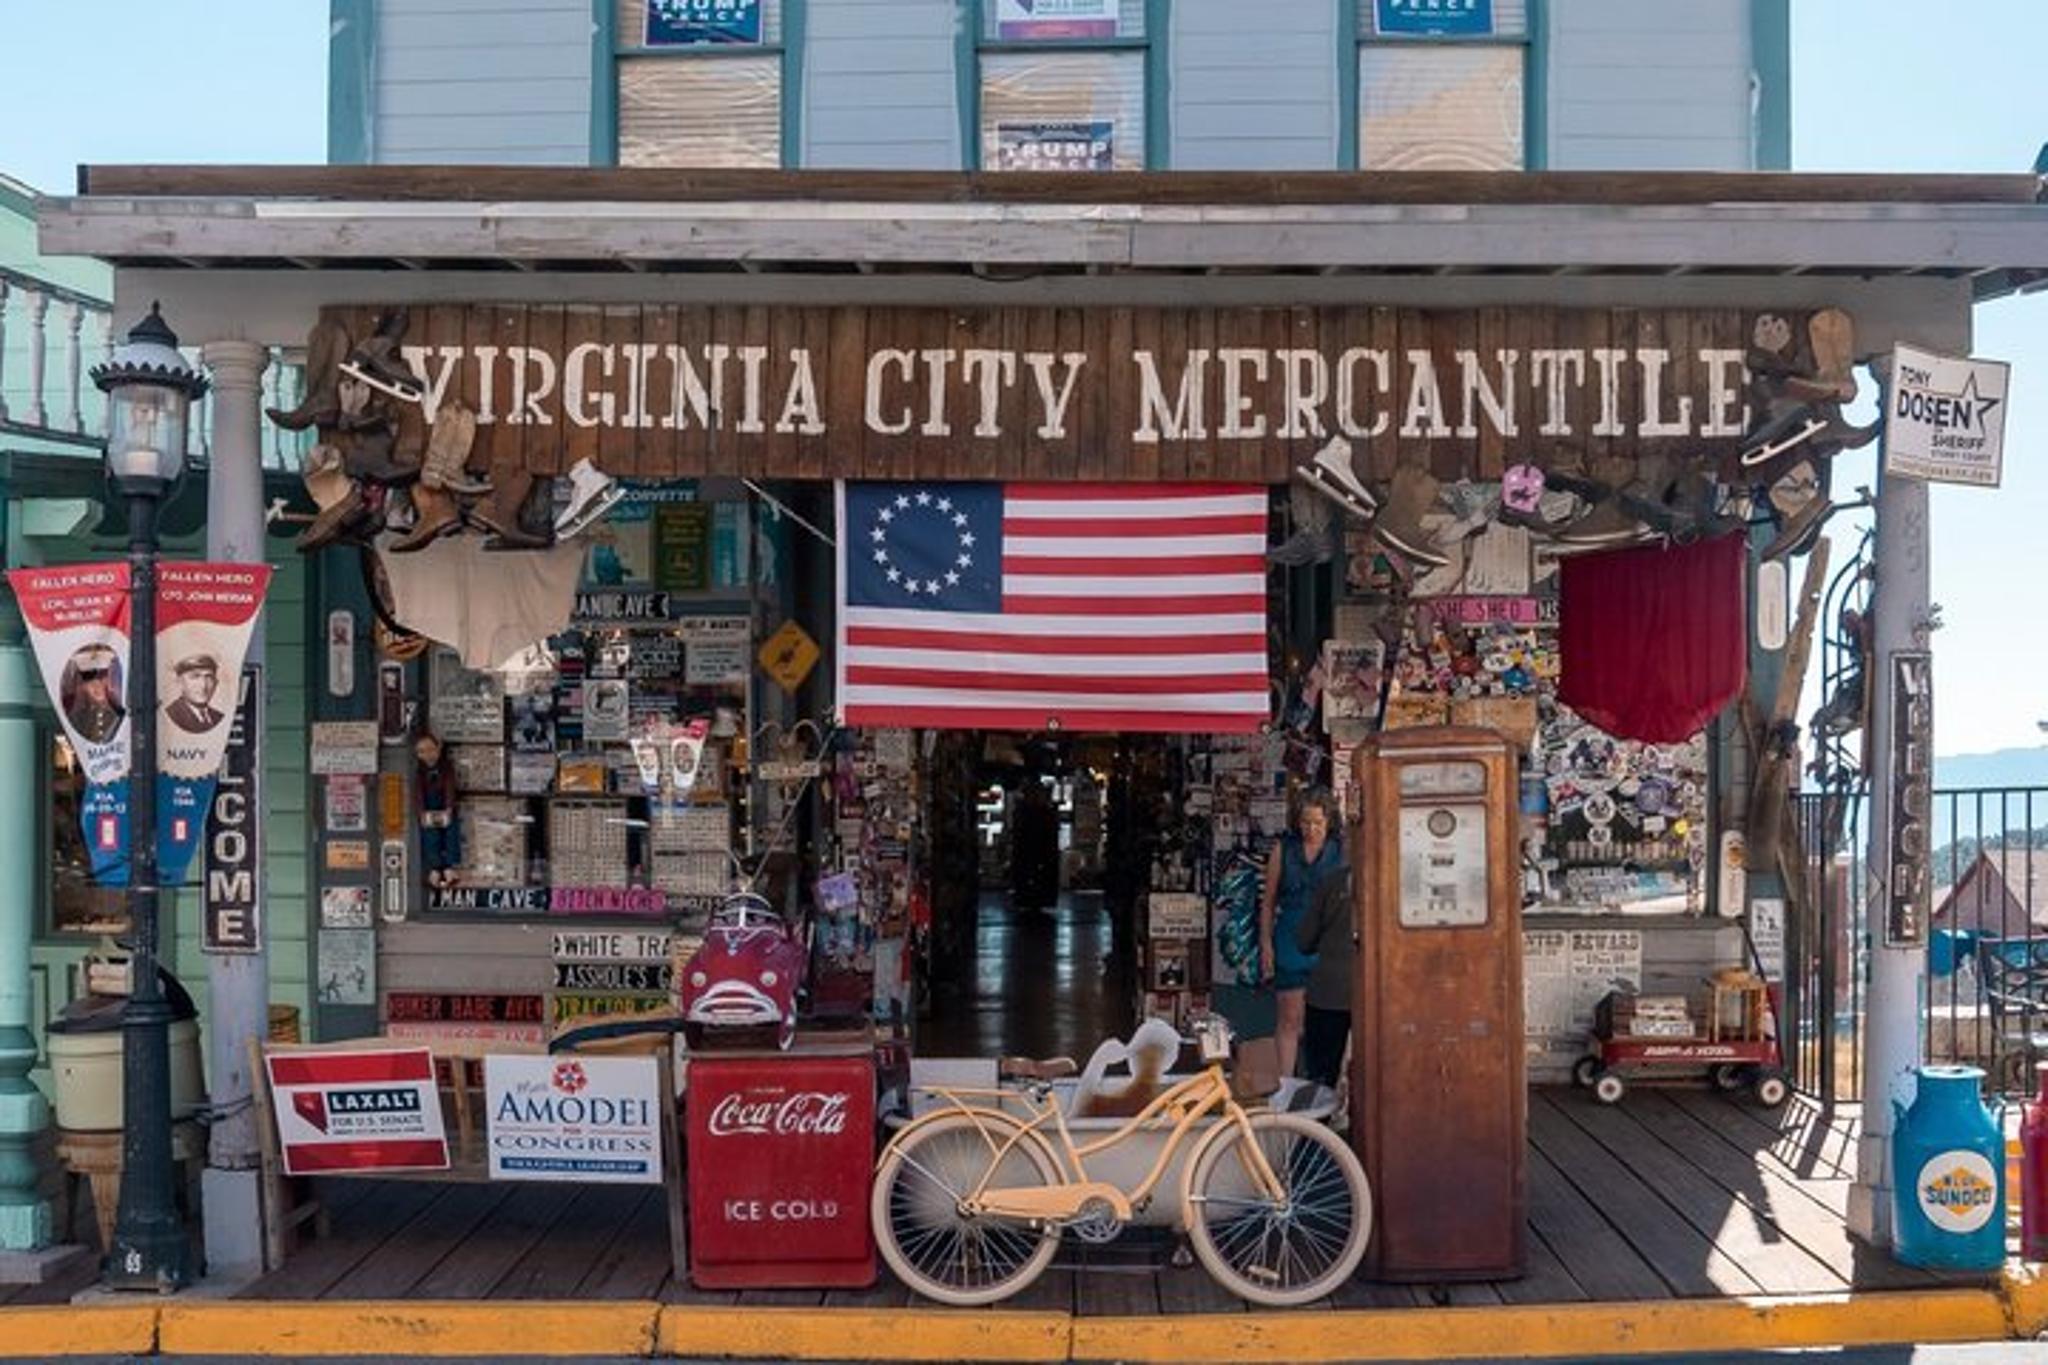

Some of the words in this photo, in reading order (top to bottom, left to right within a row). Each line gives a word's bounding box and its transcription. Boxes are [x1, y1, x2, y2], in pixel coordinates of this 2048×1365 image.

[999, 141, 1108, 157] TRUMP
[1901, 366, 1932, 387] TONY
[400, 343, 826, 434] VIRGINIA
[865, 348, 1087, 440] CITY
[1133, 347, 1752, 443] MERCANTILE
[1897, 388, 1972, 430] DOSEN
[1931, 434, 1986, 451] SHERIFF
[31, 577, 78, 589] FALLEN
[80, 572, 115, 586] HERO
[161, 572, 214, 582] FALLEN
[215, 573, 255, 585] HERO
[1475, 600, 1520, 622] SHED
[166, 748, 208, 760] NAVY
[439, 888, 477, 909] MAN
[488, 888, 536, 909] CAVE
[563, 935, 622, 957] WHITE
[331, 1091, 416, 1111] LAXALT
[497, 1091, 649, 1127] AMODEI
[331, 1116, 354, 1127] FOR
[379, 1113, 423, 1127] SENATE
[708, 1093, 850, 1137] Coca-Cola
[494, 1135, 652, 1151] CONGRESS
[1925, 1186, 1992, 1206] SUNOCO
[723, 1200, 763, 1222] ICE
[769, 1200, 839, 1221] COLD
